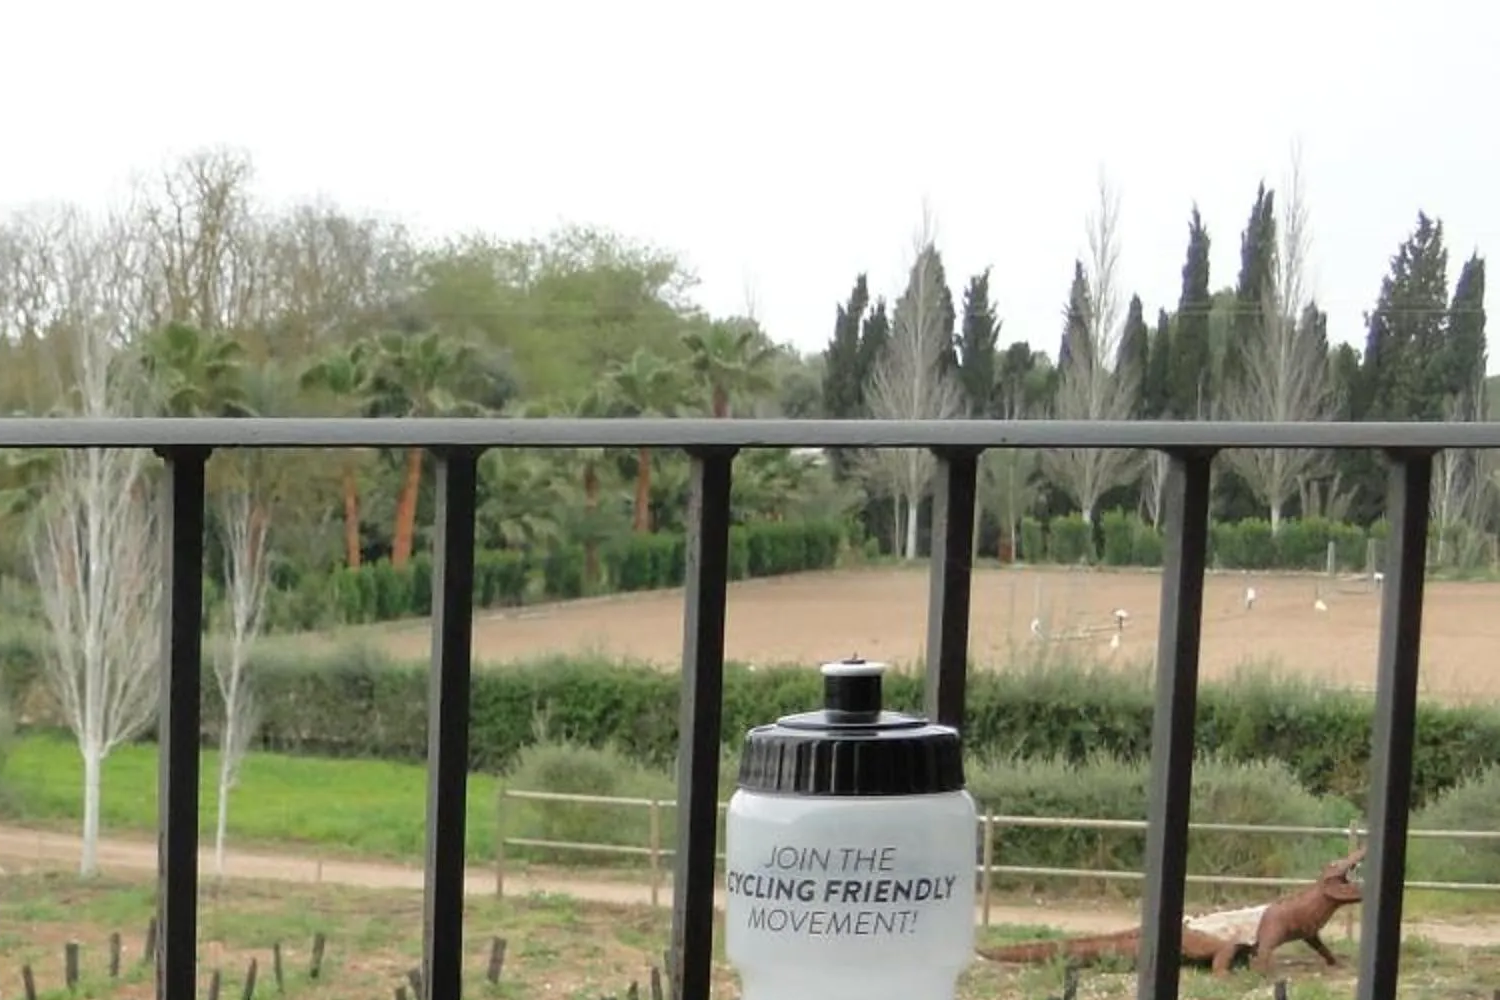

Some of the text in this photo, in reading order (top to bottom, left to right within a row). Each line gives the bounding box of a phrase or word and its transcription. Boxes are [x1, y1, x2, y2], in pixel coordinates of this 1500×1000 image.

[763, 846, 898, 872] JOIN THE
[727, 870, 958, 904] CYCLING FRIENDLY
[747, 907, 919, 936] MOVEMENT!
